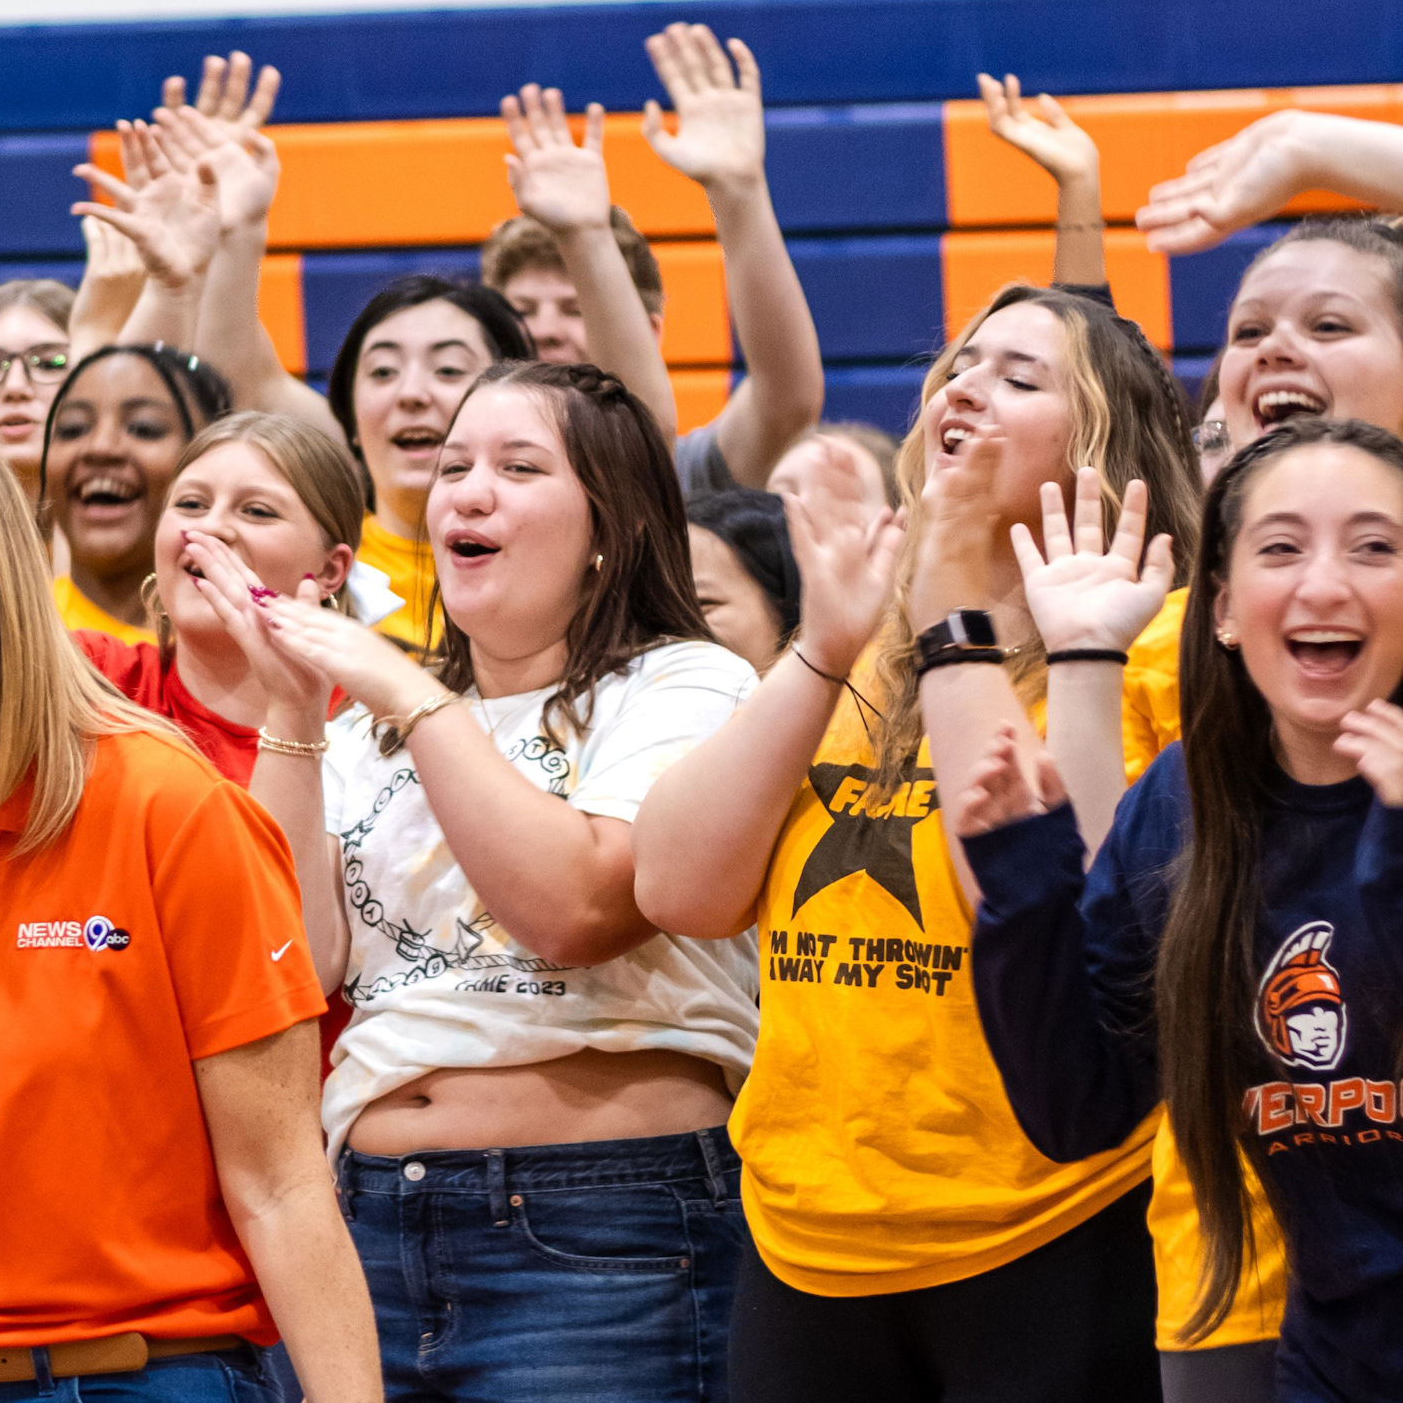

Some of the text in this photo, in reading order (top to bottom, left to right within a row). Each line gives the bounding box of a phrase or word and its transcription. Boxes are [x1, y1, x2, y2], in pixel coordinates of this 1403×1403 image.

[17, 937, 84, 948] CHANNEL
[18, 921, 82, 938] NEWS
[106, 932, 130, 945] abc
[798, 932, 837, 958] NOT
[834, 962, 884, 988] MY
[515, 980, 567, 997] 2023
